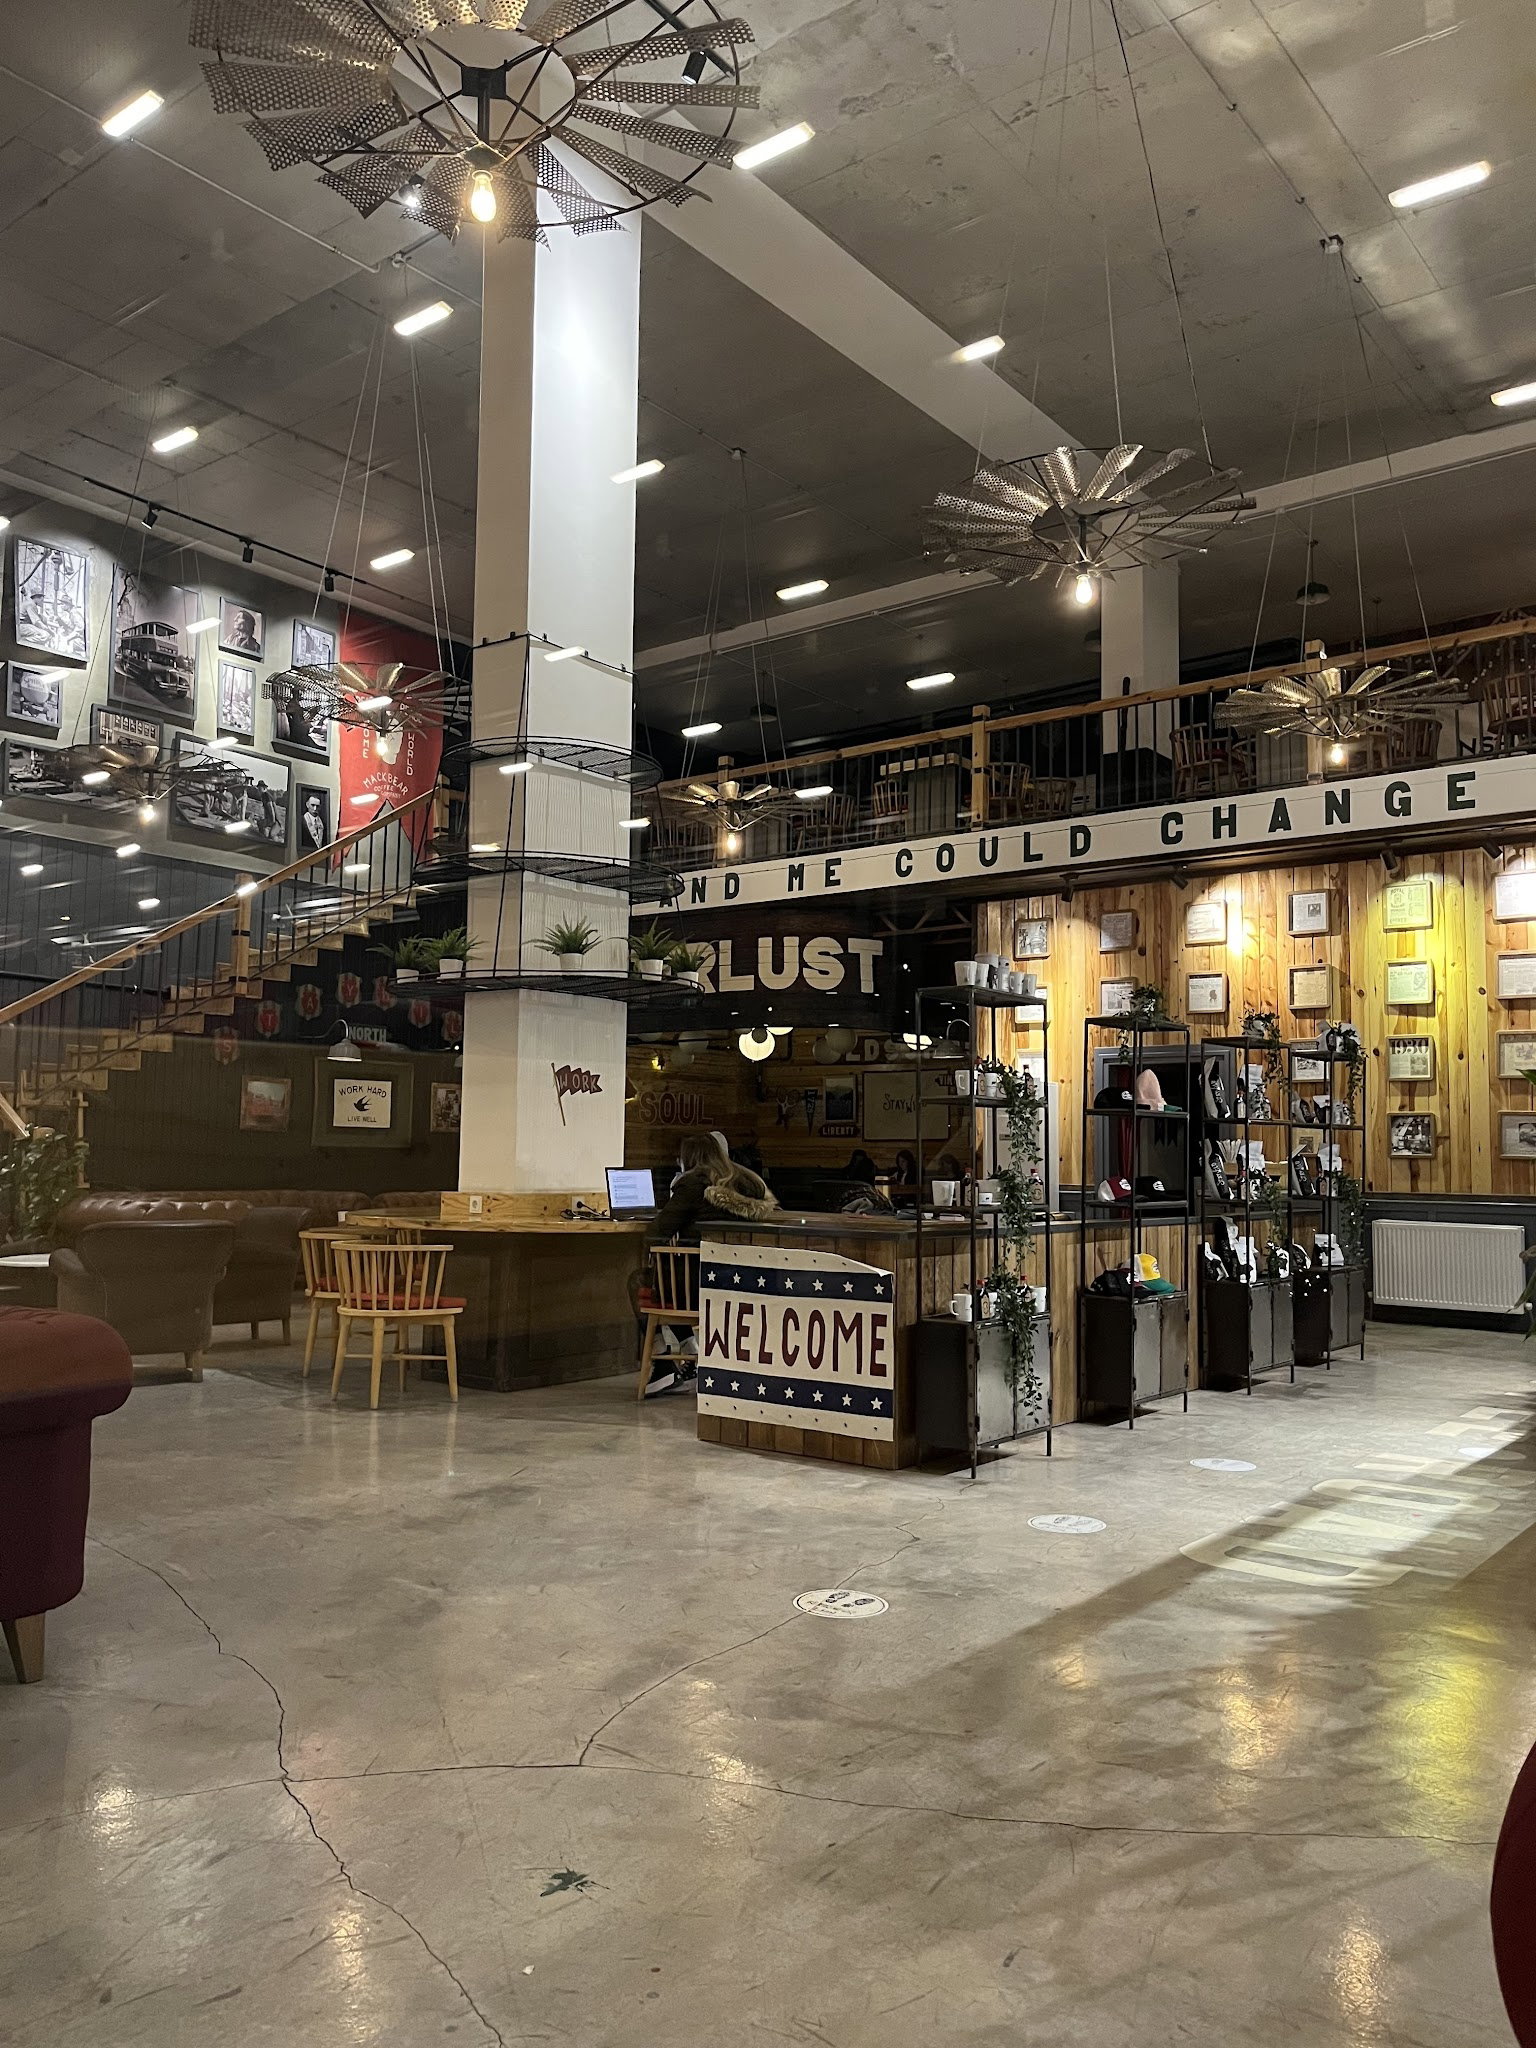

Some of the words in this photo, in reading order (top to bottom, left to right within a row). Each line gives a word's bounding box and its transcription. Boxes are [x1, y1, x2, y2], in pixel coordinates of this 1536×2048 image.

[406, 732, 415, 776] WORLD
[787, 857, 842, 892] ME
[895, 824, 1092, 878] COULD
[1160, 771, 1476, 846] CHANGE
[348, 1025, 387, 1043] NORTH
[338, 1085, 364, 1097] WORK
[366, 1086, 387, 1098] HARD
[559, 1073, 598, 1092] WORK
[639, 1091, 714, 1126] SOUL
[704, 1298, 888, 1378] WELCOME
